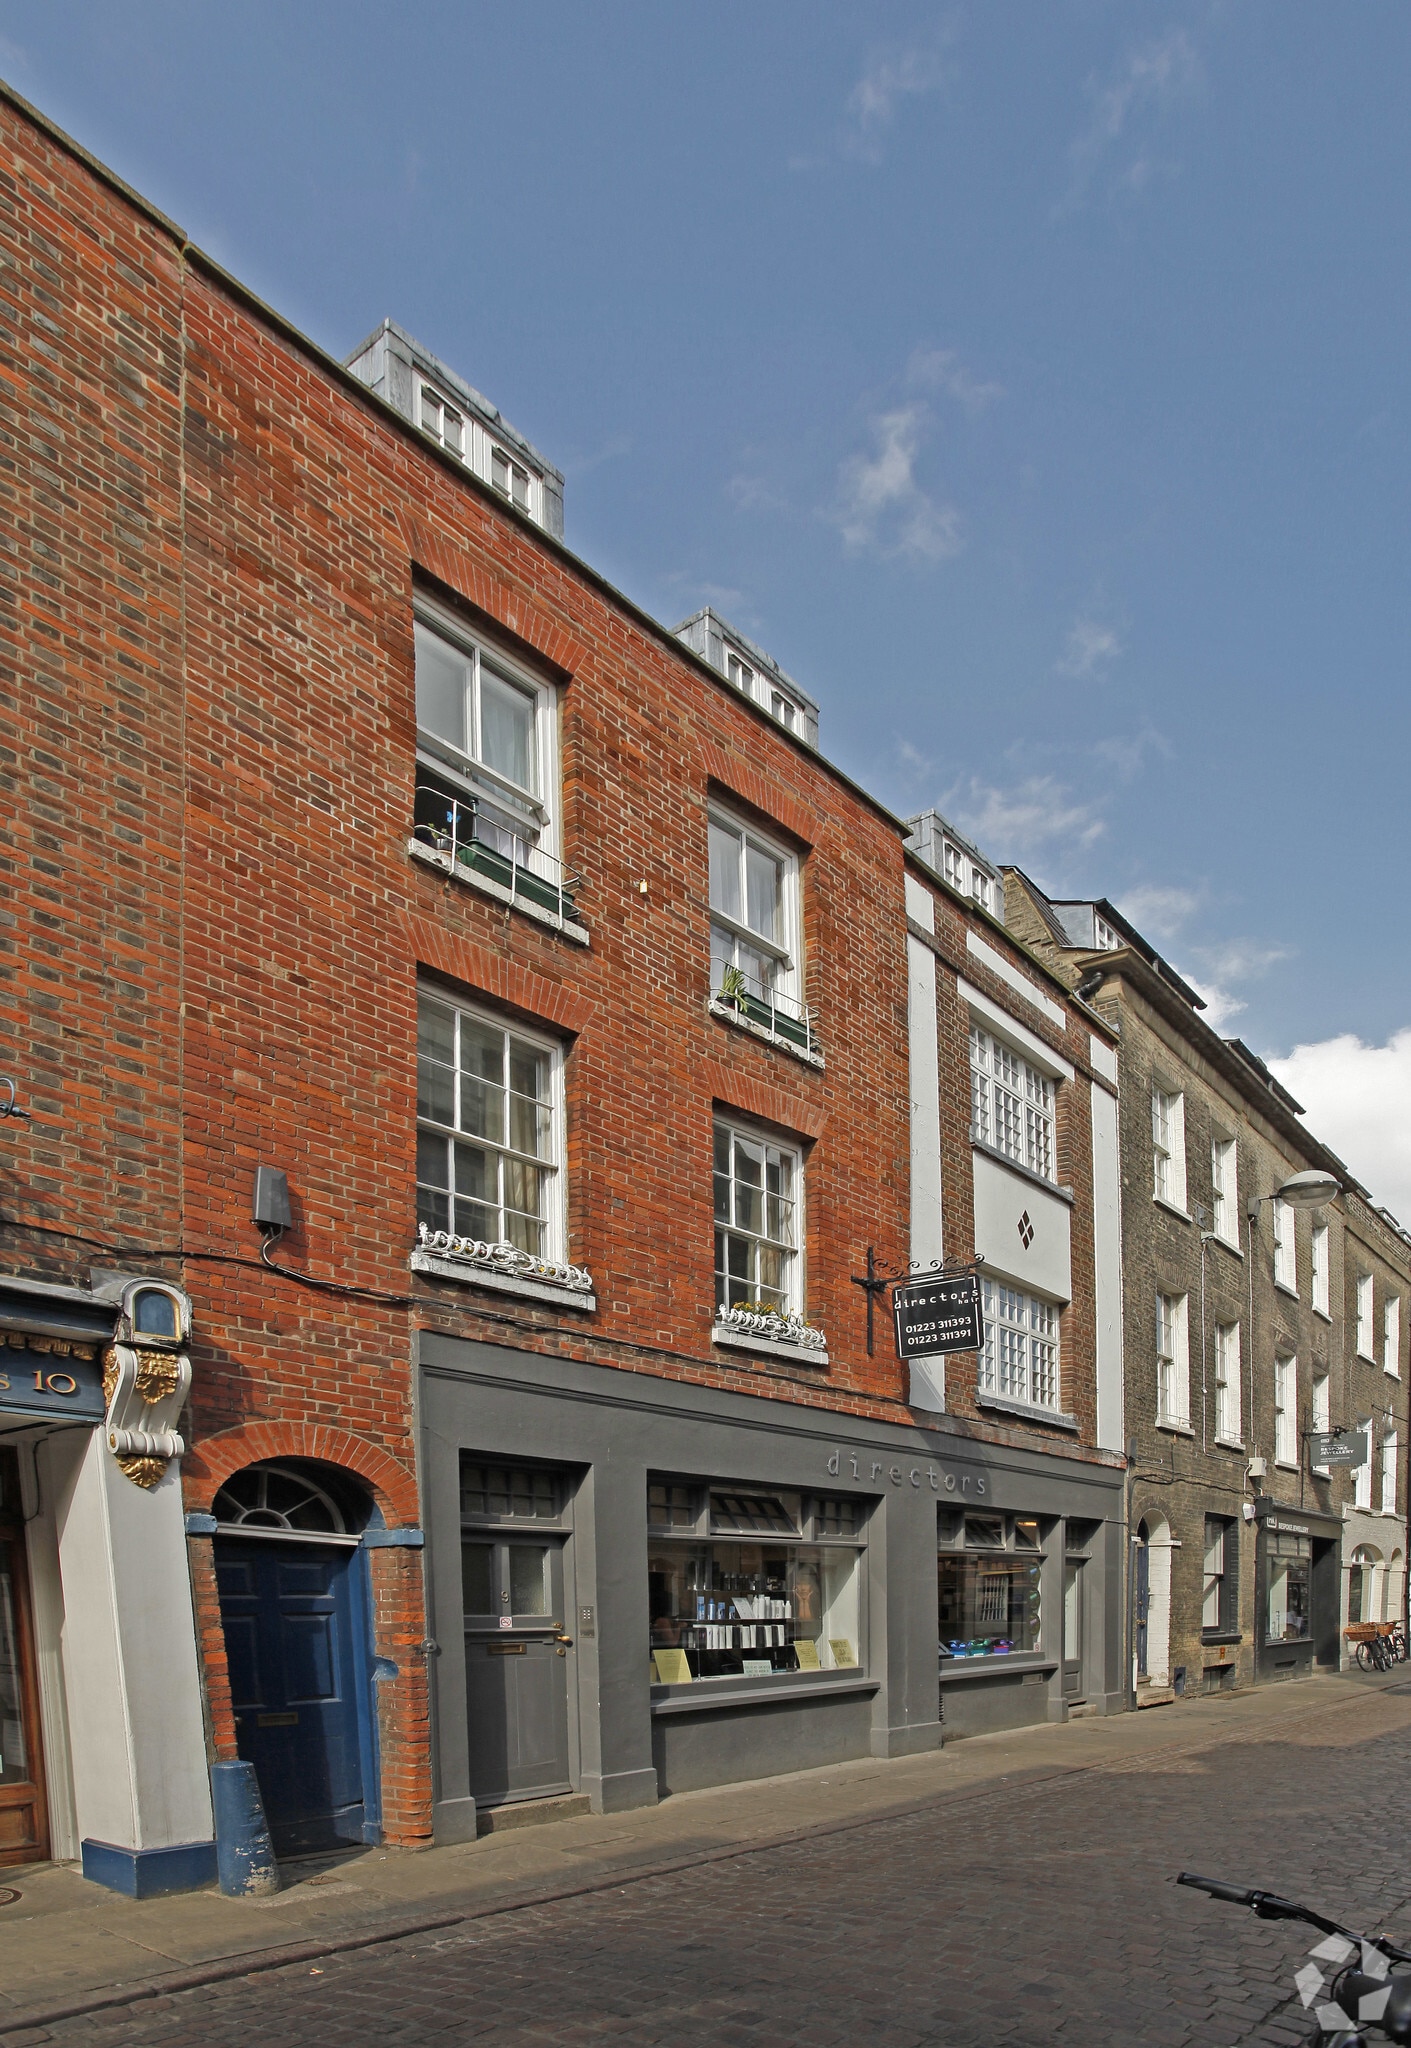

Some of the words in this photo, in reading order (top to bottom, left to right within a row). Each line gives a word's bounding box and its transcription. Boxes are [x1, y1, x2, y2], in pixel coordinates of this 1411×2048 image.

[894, 1289, 979, 1309] directors
[906, 1322, 935, 1333] 01223
[938, 1317, 971, 1328] 311393
[908, 1334, 937, 1345] 01223
[940, 1330, 971, 1340] 311391
[32, 1369, 77, 1394] 10
[826, 1449, 986, 1495] directors
